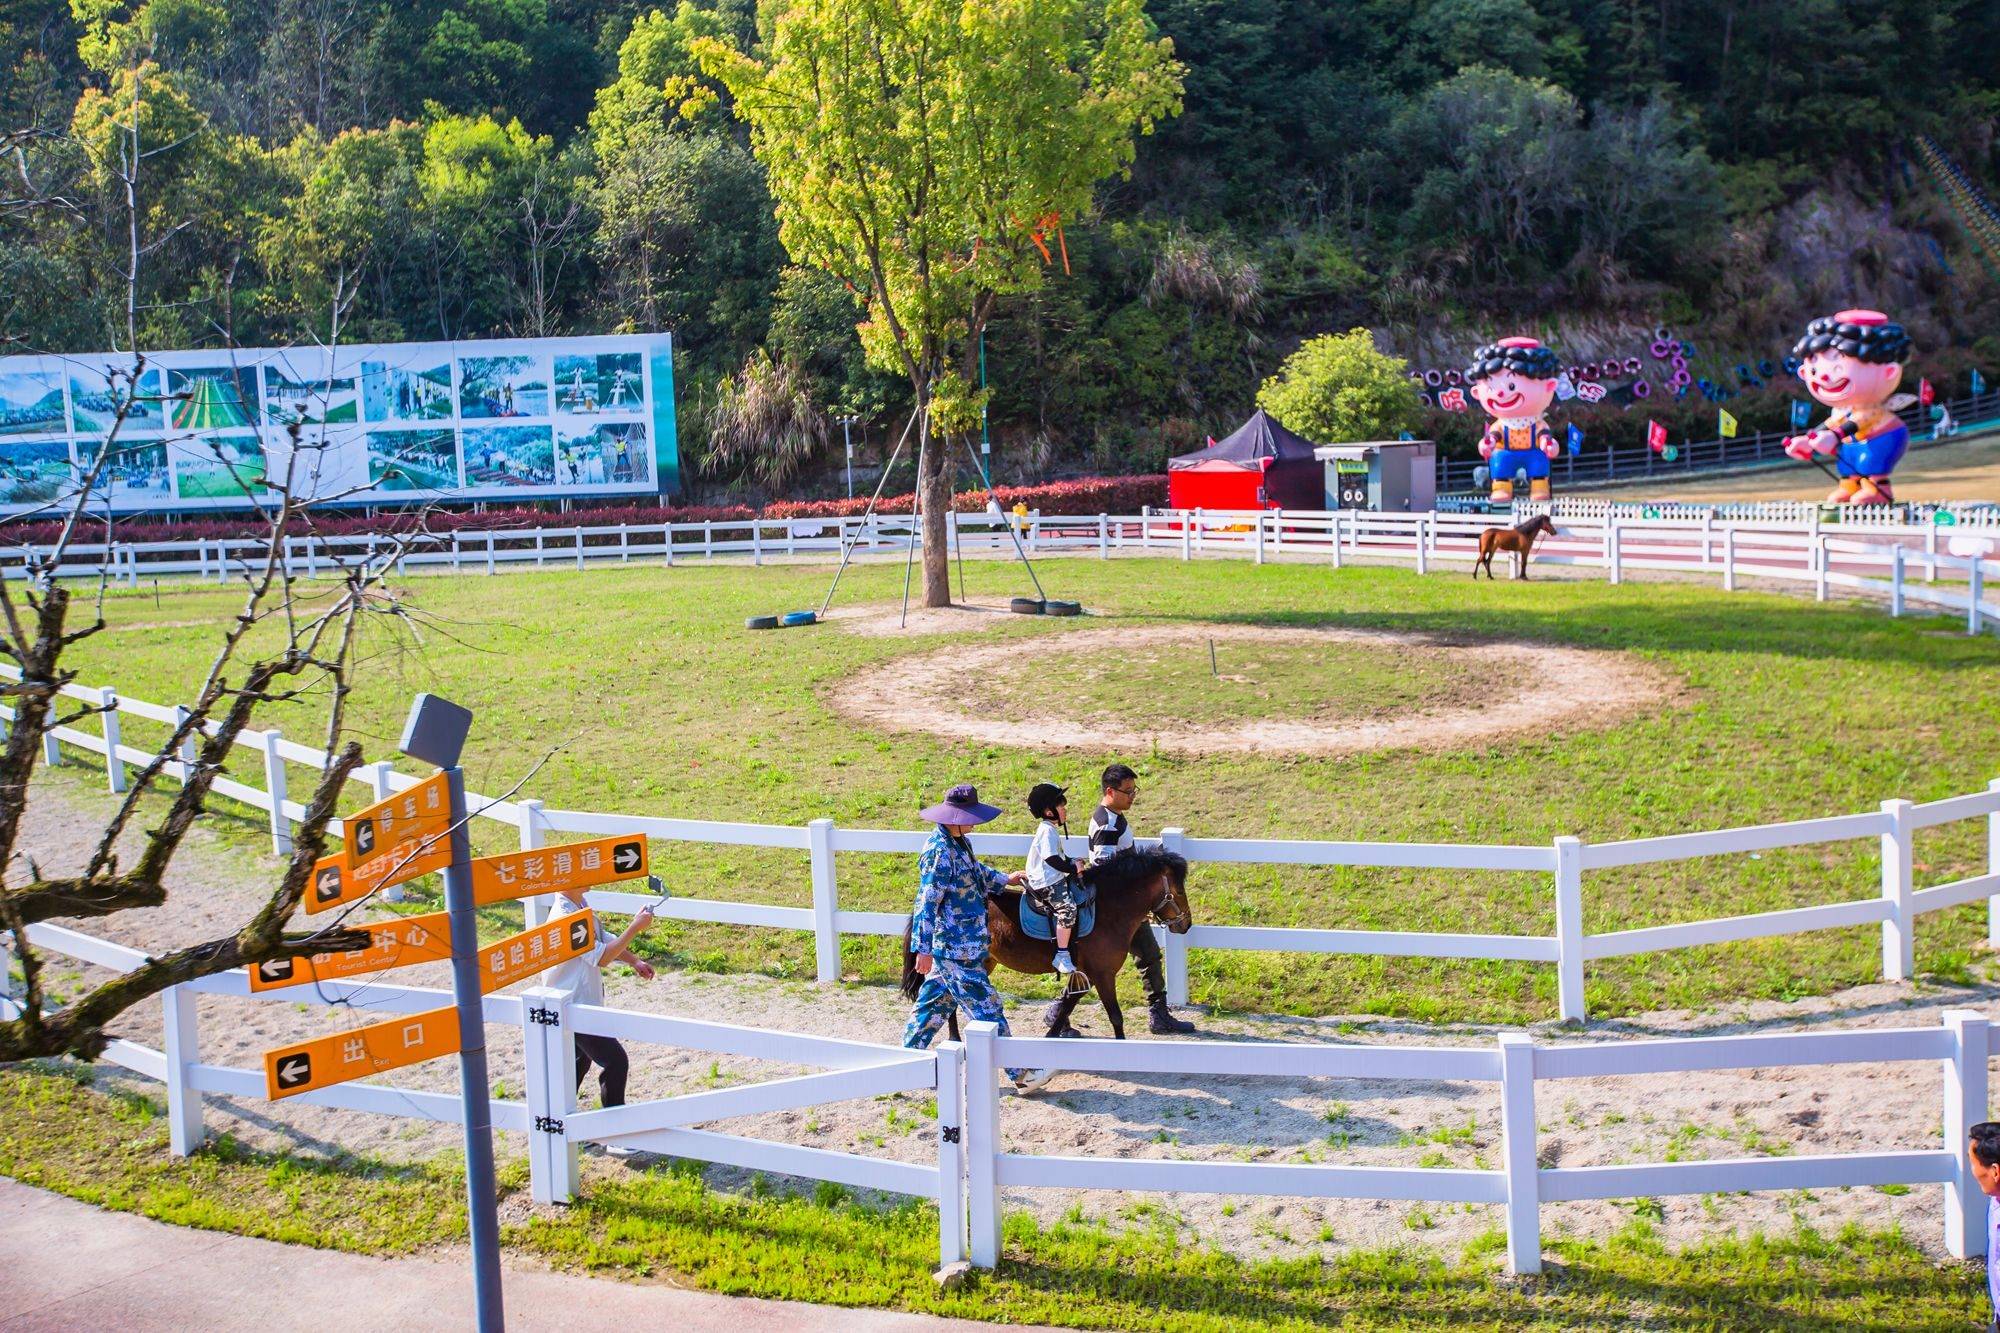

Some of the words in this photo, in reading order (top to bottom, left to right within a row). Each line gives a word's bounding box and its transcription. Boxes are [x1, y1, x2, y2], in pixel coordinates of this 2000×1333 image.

[495, 847, 601, 884] 七彩滑道
[336, 960, 367, 971] Tourist
[369, 954, 397, 967] Center
[490, 927, 563, 973] 哈哈滑草
[343, 1023, 424, 1063] 出口
[373, 1058, 391, 1066] Exit
